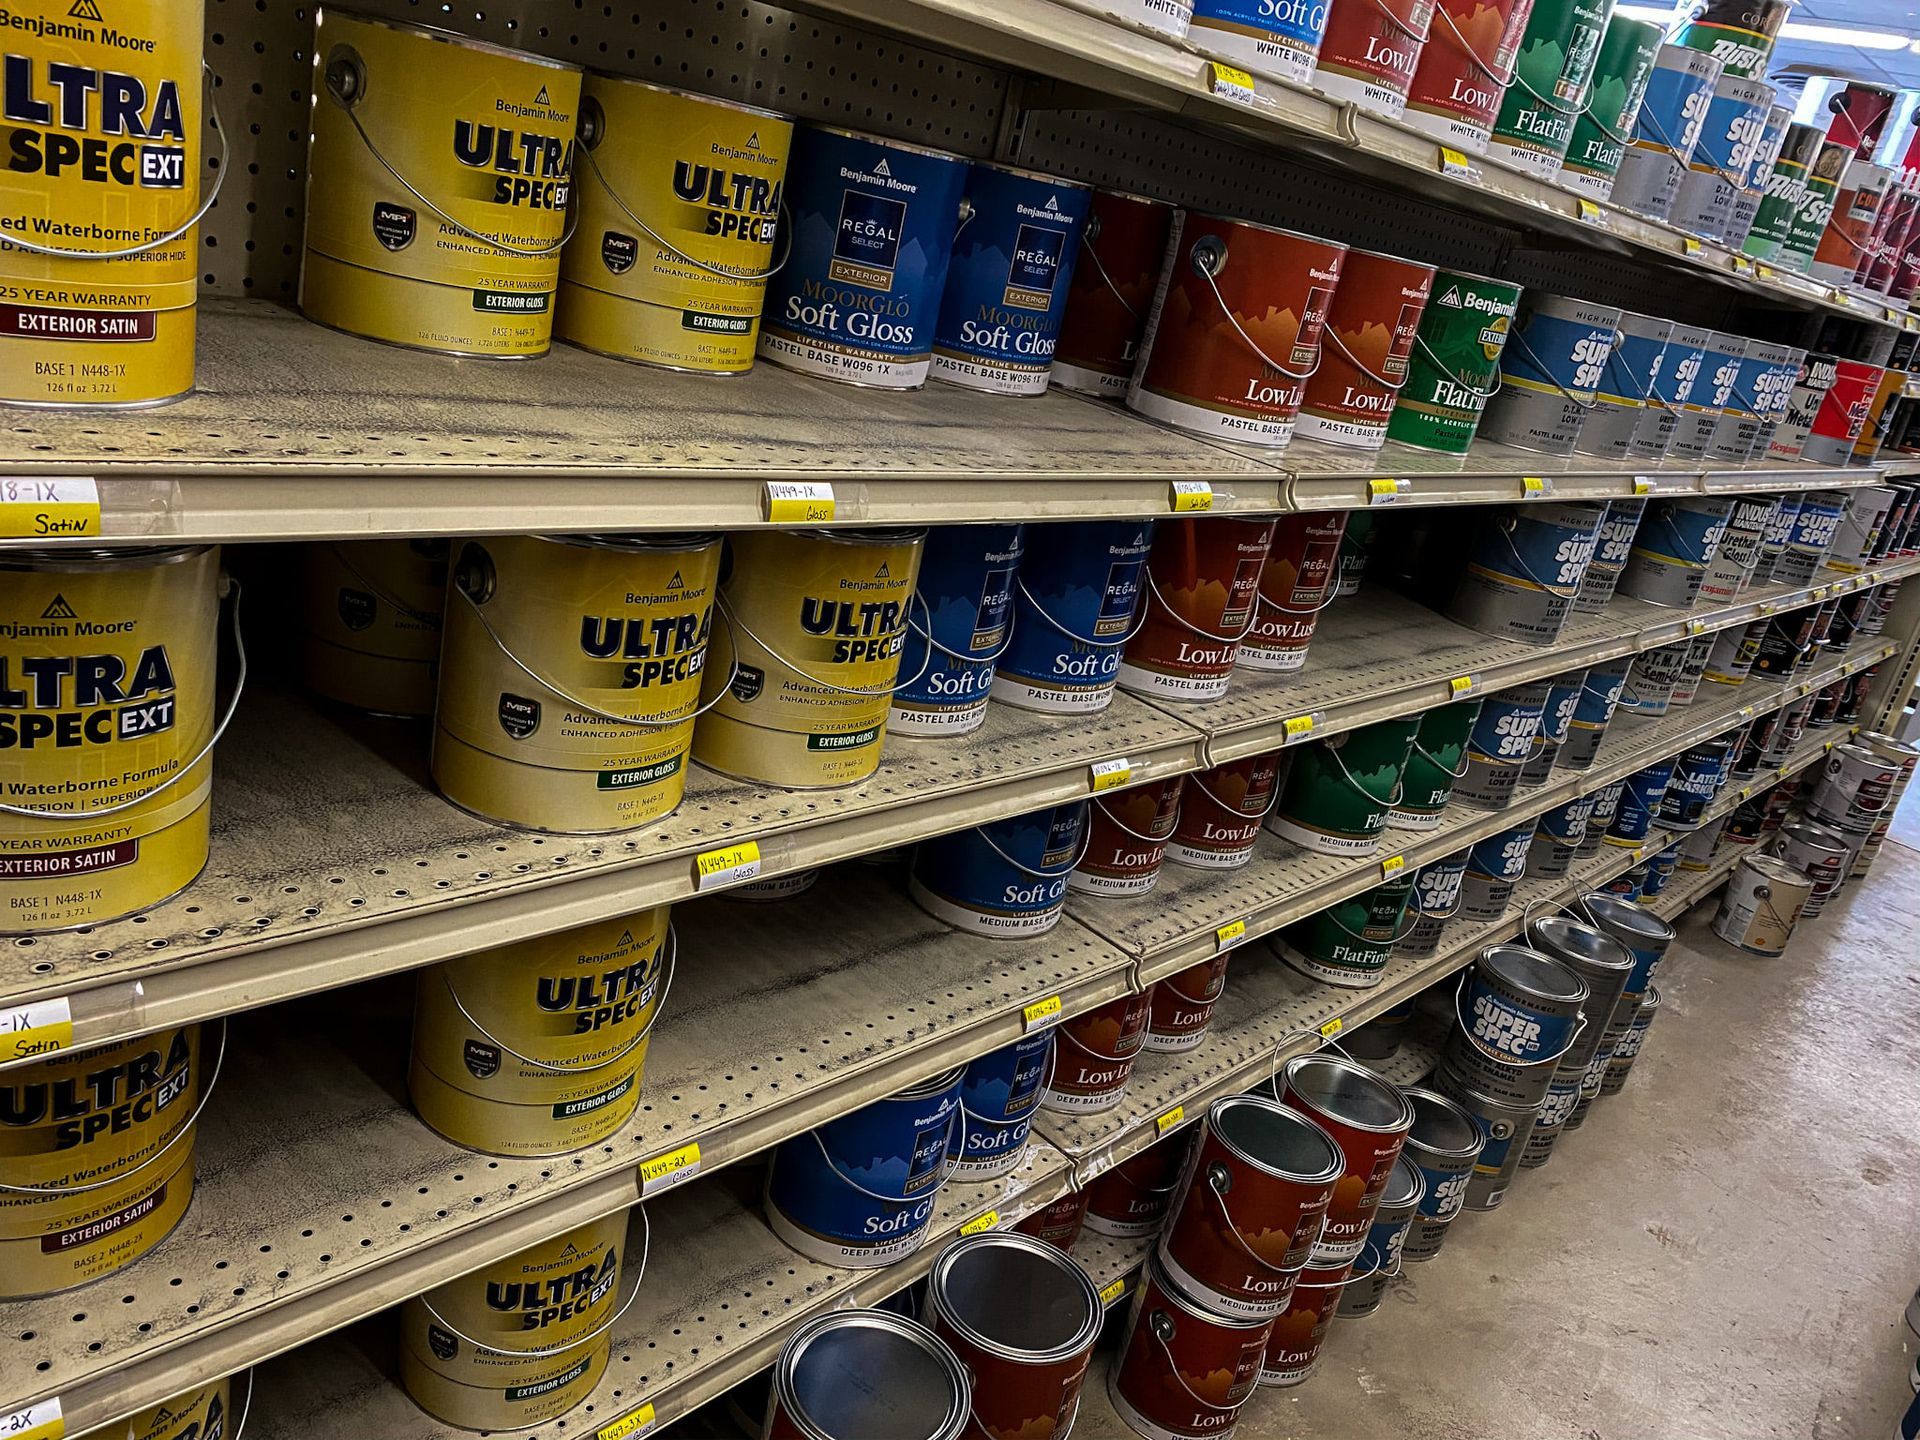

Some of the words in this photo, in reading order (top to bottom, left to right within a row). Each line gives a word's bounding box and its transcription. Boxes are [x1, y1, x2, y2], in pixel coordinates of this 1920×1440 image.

[0, 10, 95, 42] Benjamin
[101, 29, 154, 52] Moore
[1256, 42, 1290, 60] WHITE
[1365, 85, 1391, 103] WHITE
[496, 100, 546, 120] Benjamin
[1450, 123, 1475, 138] WHITE
[9, 128, 135, 186] SPEC
[142, 152, 183, 180] EXT
[453, 118, 572, 180] ULTRA
[711, 143, 755, 162] Benjamin
[1511, 148, 1538, 162] WHITE
[672, 159, 781, 216] ULTRA
[840, 167, 885, 187] Benjamin
[887, 179, 916, 193] Moore
[1580, 176, 1600, 188] WHITE
[494, 176, 554, 209] SPEC
[1017, 204, 1053, 220] Benjamin
[32, 218, 140, 241] Waterborne
[705, 210, 761, 241] SPEC
[842, 219, 895, 241] REGAL
[436, 240, 490, 256] ENHANCED
[851, 236, 884, 249] SELECT
[1016, 250, 1057, 267] REGAL
[653, 266, 699, 280] ENHANCED
[835, 266, 887, 284] EXTERIOR
[478, 277, 490, 286] 25
[492, 278, 514, 288] YEAR
[23, 288, 68, 303] YEAR
[72, 293, 151, 305] WARRANTY
[486, 295, 524, 308] EXTERIOR
[526, 297, 544, 308] GLOSS
[1464, 292, 1516, 317] Benjamin
[699, 301, 720, 311] YEAR
[18, 313, 97, 334] EXTERIOR
[100, 319, 138, 335] SATIN
[694, 316, 729, 329] EXTERIOR
[730, 318, 747, 330] GLOSS
[786, 296, 839, 332] Soft
[846, 312, 914, 344] Gloss
[960, 321, 1009, 350] Soft
[796, 335, 841, 352] LIFETIME
[846, 347, 895, 361] WARRANTY
[35, 362, 65, 376] BASE
[82, 364, 126, 376] N448-1X
[807, 349, 840, 366] BASE
[843, 360, 873, 372] W096
[936, 358, 977, 376] PASTEL
[980, 367, 1007, 381] BASE
[971, 356, 1009, 369] LIFETIME
[1221, 417, 1259, 431] PASTEL
[1262, 424, 1281, 435] BASE
[1320, 420, 1354, 436] PASTEL
[1357, 427, 1375, 437] BASE
[771, 485, 815, 497] N449-1X
[807, 505, 828, 520] Gloss
[840, 579, 885, 593] Benjamin
[1107, 583, 1137, 595] REGAL
[625, 591, 679, 607] Benjamin
[801, 594, 912, 637] ULTRA
[75, 620, 134, 636] Moore
[581, 604, 711, 659] ULTRA
[832, 638, 889, 664] SPEC
[622, 659, 688, 689] SPEC
[1053, 654, 1098, 676] Soft
[927, 670, 975, 695] Soft
[1154, 676, 1191, 690] PASTEL
[1194, 680, 1214, 690] BASE
[779, 695, 826, 706] ENHANCED
[1027, 689, 1068, 702] PASTEL
[1071, 691, 1094, 702] BASE
[0, 709, 112, 749] SPEC
[121, 702, 173, 735] EXT
[825, 721, 846, 731] YEAR
[901, 712, 943, 724] PASTEL
[948, 713, 970, 723] BASE
[561, 729, 616, 738] ENHANCED
[819, 734, 855, 747] EXTERIOR
[856, 729, 873, 744] GLOSS
[603, 759, 615, 767] 25
[617, 755, 642, 766] YEAR
[9, 777, 118, 795] Waterborne
[123, 759, 179, 785] Formula
[611, 769, 653, 785] EXTERIOR
[655, 761, 675, 777] GLOSS
[1389, 811, 1417, 822] MEDIUM
[1419, 814, 1433, 822] BASE
[0, 841, 42, 849] YEAR
[47, 826, 132, 847] WARRANTY
[1320, 836, 1353, 847] MEDIUM
[1354, 839, 1371, 848] BASE
[75, 850, 116, 868] SATIN
[701, 852, 744, 874] N449-1X
[1182, 848, 1216, 861] MEDIUM
[1219, 853, 1237, 861] BASE
[1090, 878, 1126, 888] MEDIUM
[1128, 878, 1146, 888] BASE
[10, 897, 39, 908] BASE
[55, 889, 102, 905] N448-1X
[1003, 884, 1046, 904] Soft
[22, 913, 38, 921] 126
[66, 908, 85, 918] 3.72
[1372, 906, 1398, 914] REGAL
[979, 916, 1020, 927] MEDIUM
[1022, 918, 1043, 927] BASE
[577, 947, 629, 965] Benjamin
[535, 943, 662, 1012] ULTRA
[574, 999, 640, 1034] SPEC
[1473, 997, 1540, 1041] SUPER
[1473, 1018, 1526, 1055] SPEC
[0, 1030, 190, 1126] ULTRA
[565, 1094, 606, 1114] EXTERIOR
[607, 1081, 628, 1101] GLOSS
[572, 1086, 595, 1100] YEAR
[1056, 1094, 1080, 1105] DEEP
[1082, 1095, 1102, 1104] BASE
[56, 1093, 153, 1150] SPEC
[158, 1066, 187, 1106] EXT
[968, 1130, 1009, 1150] Soft
[73, 1144, 156, 1182] Waterborne
[946, 1161, 974, 1171] DEEP
[976, 1161, 998, 1171] BASE
[46, 1219, 62, 1230] 25
[64, 1208, 100, 1228] YEAR
[102, 1177, 164, 1213] WARRANTY
[61, 1215, 121, 1246] EXTERIOR
[123, 1198, 154, 1223] SATIN
[864, 1211, 908, 1236] Soft
[841, 1246, 870, 1256] DEEP
[873, 1245, 898, 1256] BASE
[73, 1254, 97, 1269] BASE
[522, 1258, 573, 1273] Benjamin
[486, 1245, 617, 1312] ULTRA
[523, 1297, 592, 1330] SPEC
[592, 1273, 615, 1304] EXT
[1220, 1297, 1254, 1313] MEDIUM
[517, 1379, 558, 1397] EXTERIOR
[560, 1365, 583, 1386] GLOSS
[523, 1373, 545, 1385] YEAR
